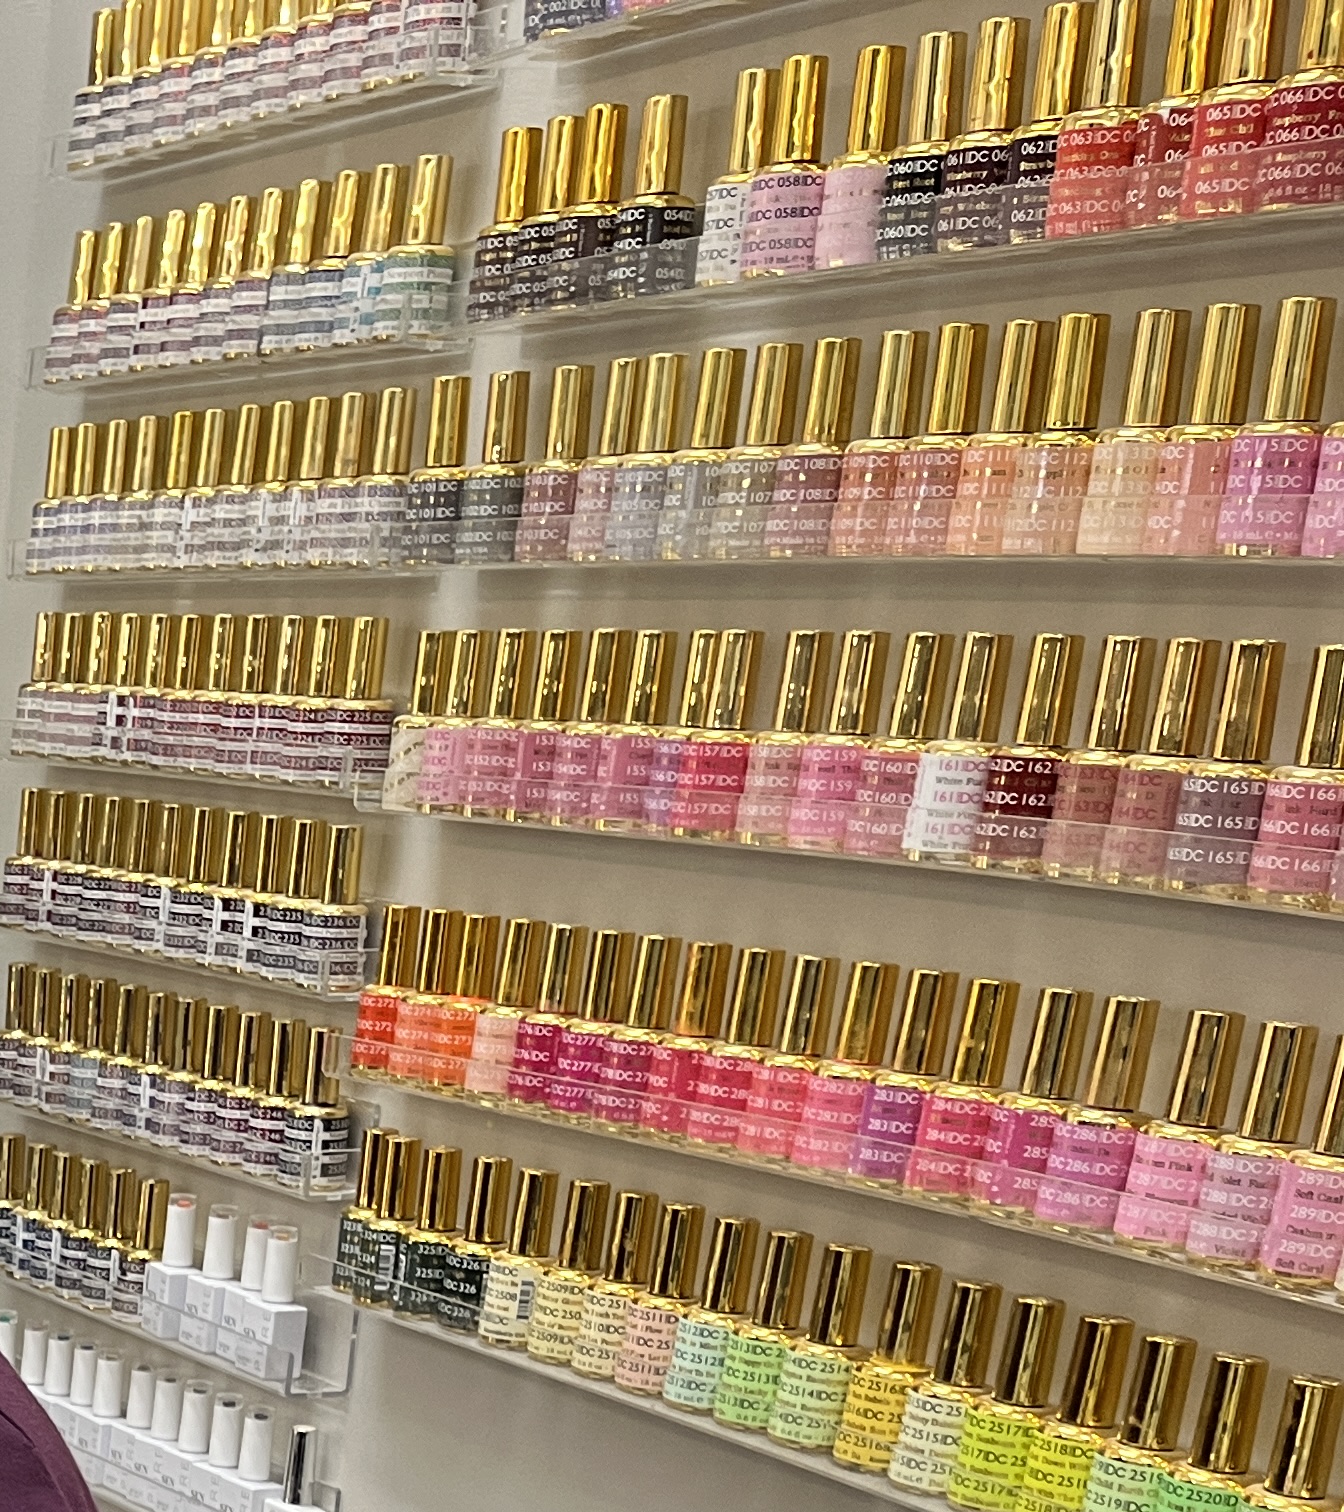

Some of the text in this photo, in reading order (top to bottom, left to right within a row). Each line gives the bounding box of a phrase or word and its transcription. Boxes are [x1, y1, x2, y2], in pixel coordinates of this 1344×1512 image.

[1280, 91, 1304, 106] 066
[1207, 107, 1230, 121] 065
[1069, 130, 1092, 145] 063
[1022, 141, 1043, 155] 062
[778, 176, 800, 188] 058
[1028, 762, 1052, 774] 162
[1223, 782, 1248, 795] 165
[1310, 787, 1336, 800] 166
